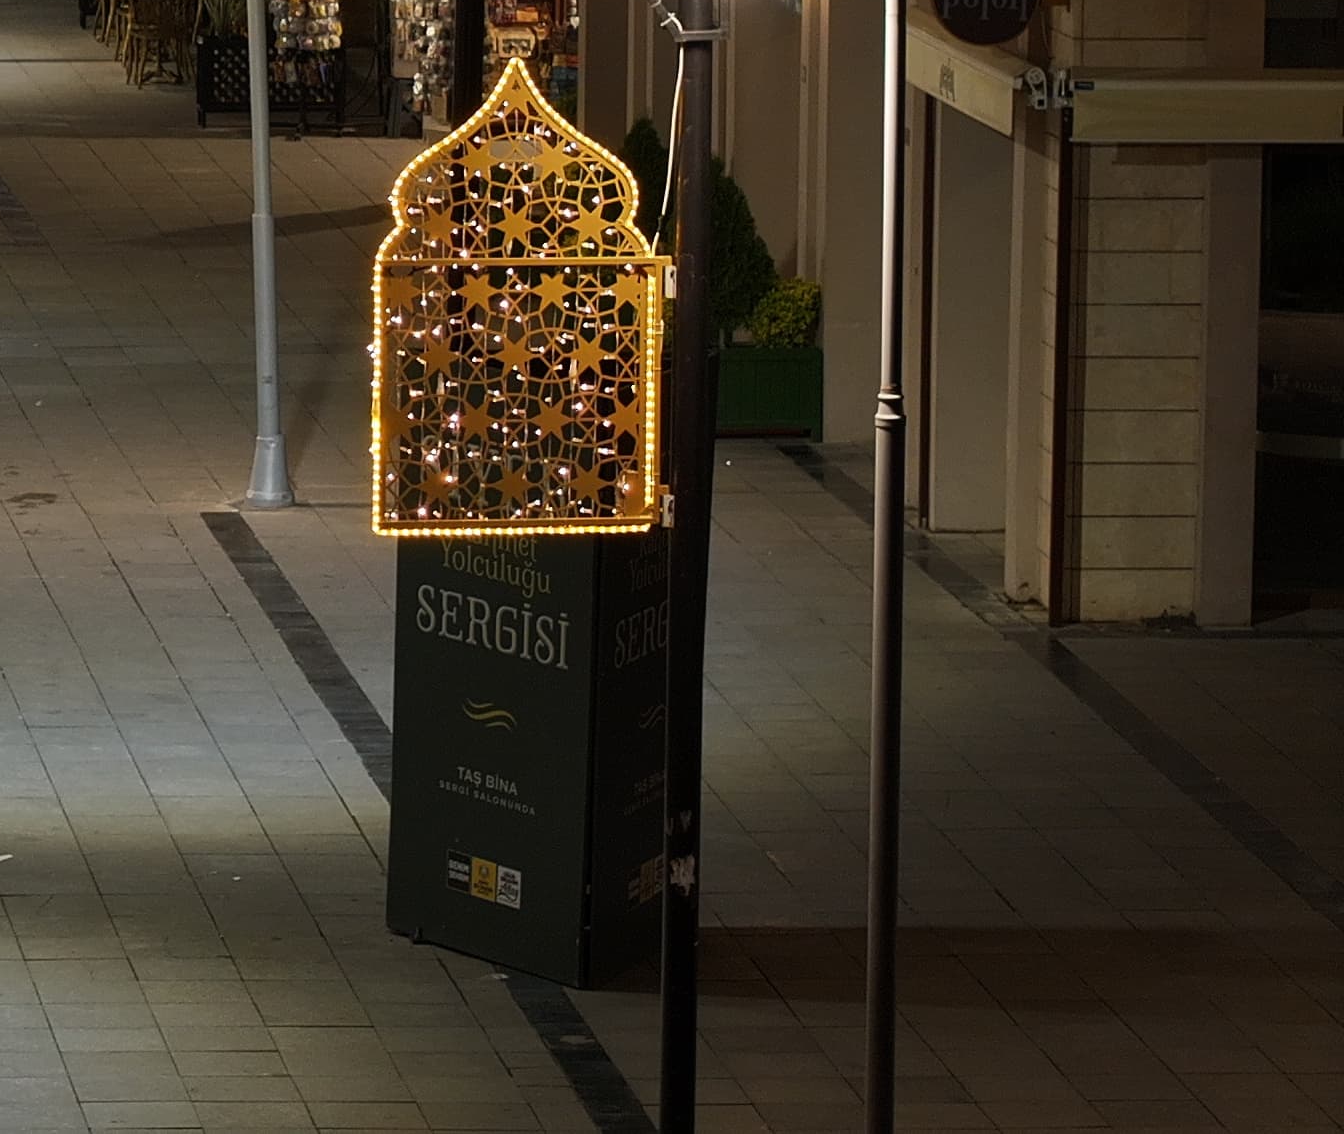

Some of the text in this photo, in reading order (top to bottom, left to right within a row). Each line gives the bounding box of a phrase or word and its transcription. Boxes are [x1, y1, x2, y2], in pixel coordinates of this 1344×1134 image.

[441, 537, 552, 599] Yolculuğu
[416, 583, 569, 670] SERGİSİ
[613, 599, 669, 668] SERG
[456, 766, 518, 796] TAŞ BİNA
